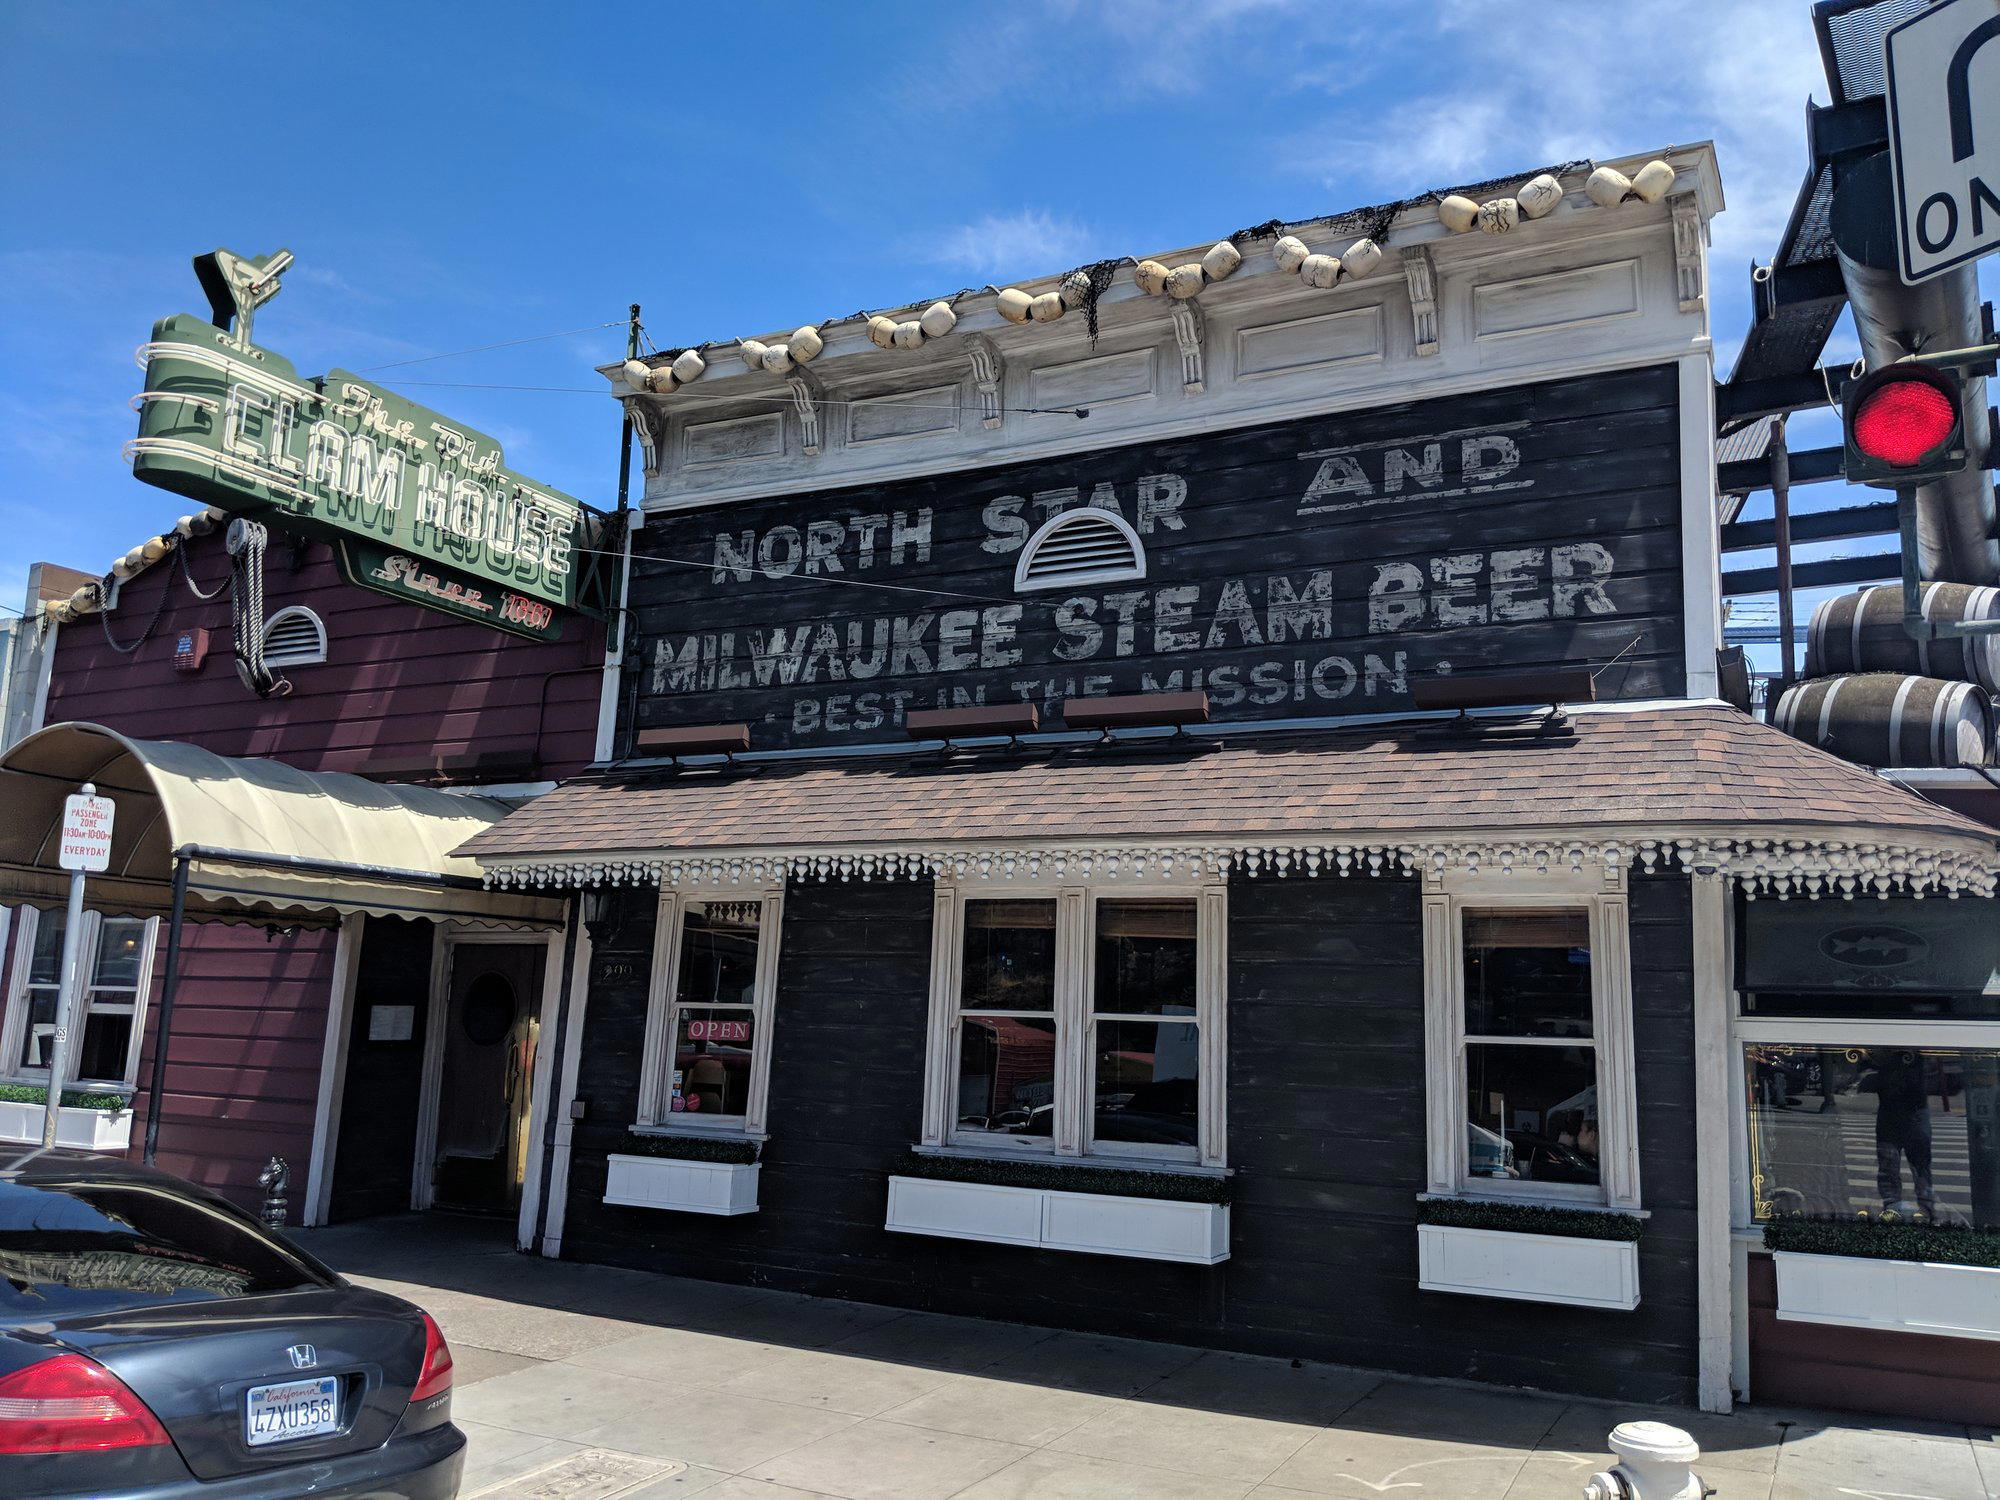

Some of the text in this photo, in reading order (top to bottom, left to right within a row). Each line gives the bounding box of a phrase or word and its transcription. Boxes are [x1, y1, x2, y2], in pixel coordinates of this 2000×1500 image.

[1916, 176, 2000, 254] ON
[330, 383, 509, 484] The Old
[223, 383, 574, 574] CLAM HOUSE
[712, 435, 1520, 584] NORTH STAR AND
[371, 555, 553, 631] Since 1861
[652, 542, 1618, 695] MILWAUKEE STEAM BEER
[792, 651, 1408, 735] BEST IN THE MISSION
[64, 845, 107, 857] EVERYDAY
[80, 818, 98, 828] ZONE
[691, 1021, 748, 1038] OPEN
[255, 1398, 331, 1434] 4ZXU358
[267, 1386, 320, 1403] California
